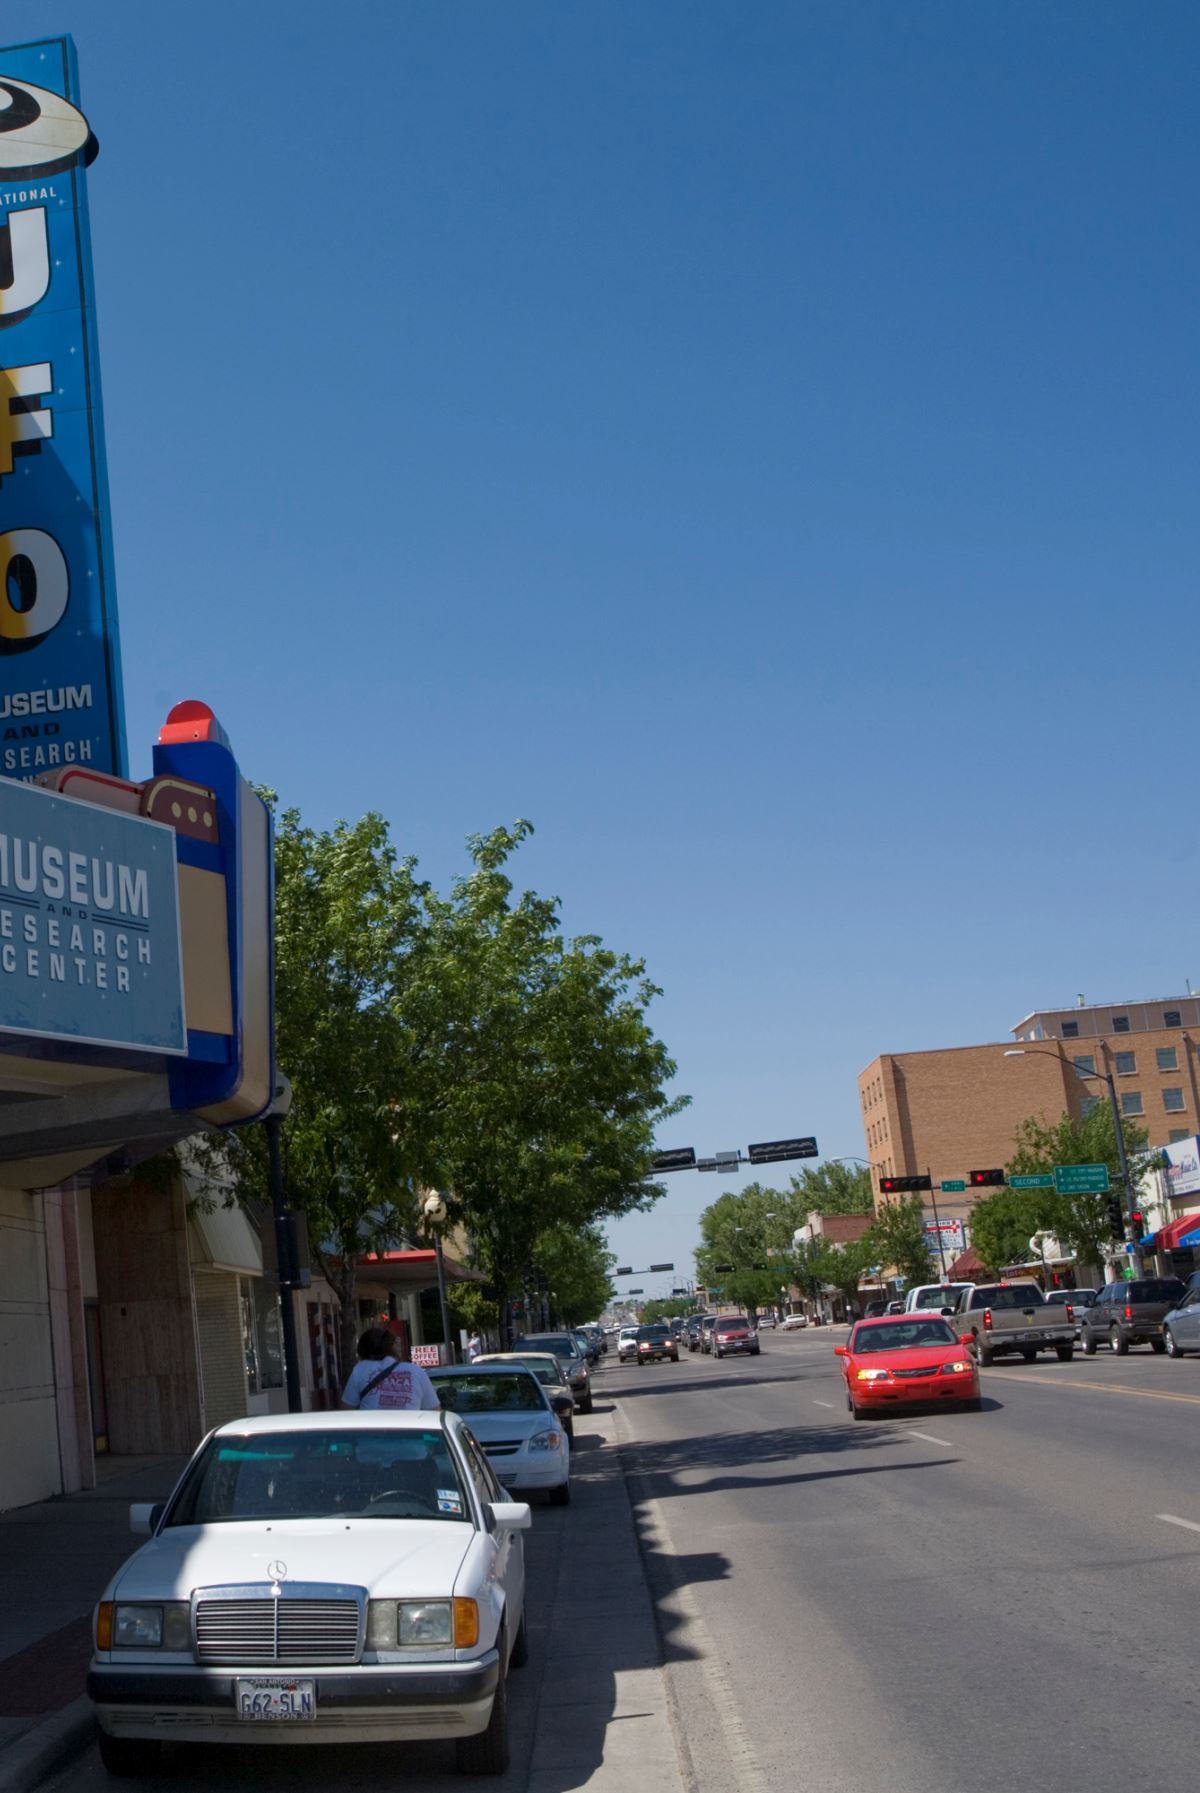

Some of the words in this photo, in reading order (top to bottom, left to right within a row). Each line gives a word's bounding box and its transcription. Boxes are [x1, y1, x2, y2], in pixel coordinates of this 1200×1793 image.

[3, 722, 60, 741] AND
[46, 903, 89, 921] AND
[2, 943, 131, 993] CENTER
[280, 1693, 311, 1713] SLN
